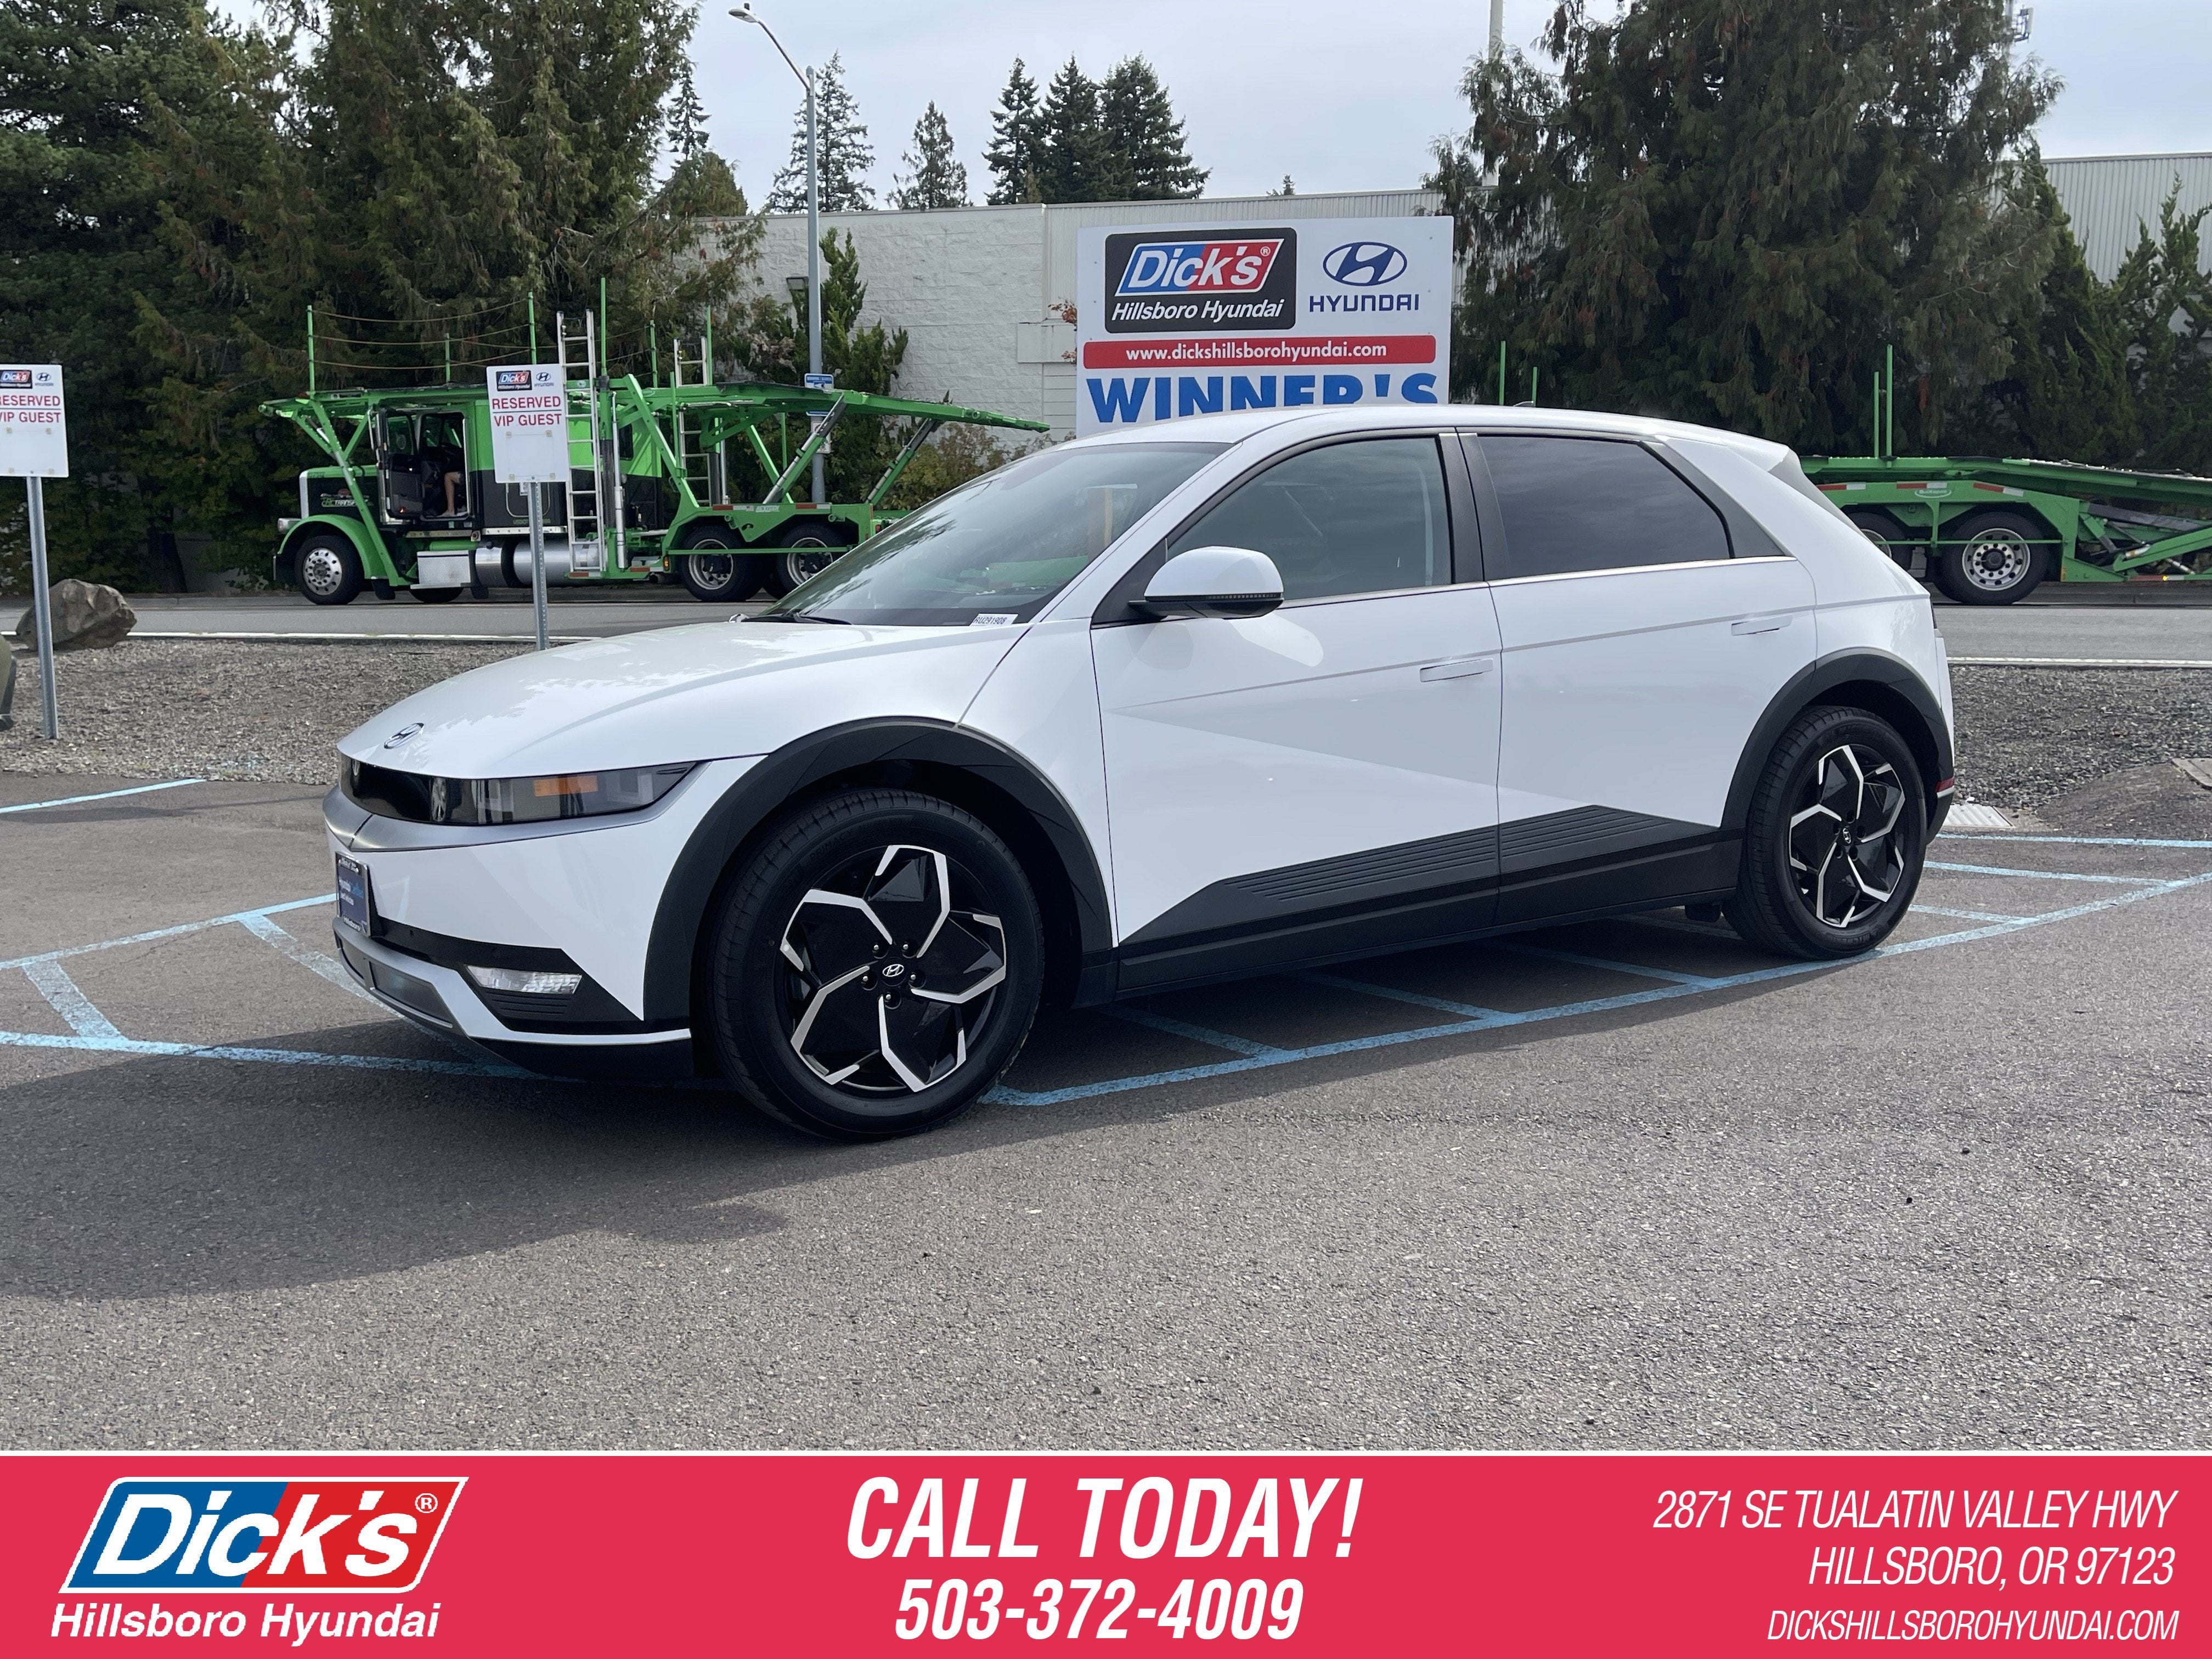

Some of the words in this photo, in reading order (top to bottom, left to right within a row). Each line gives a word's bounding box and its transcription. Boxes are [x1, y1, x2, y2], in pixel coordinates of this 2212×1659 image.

[1310, 294, 1419, 312] HYUNDAI
[1111, 302, 1198, 321] Hillsboro
[1201, 299, 1285, 323] Hyundai
[1126, 342, 1386, 362] www.dickshillsborohyundai.com
[0, 395, 61, 407] ESERVED
[492, 396, 561, 409] RESERVED
[19, 411, 61, 423] GUEST
[494, 415, 514, 427] VIP
[518, 414, 562, 426] GUEST
